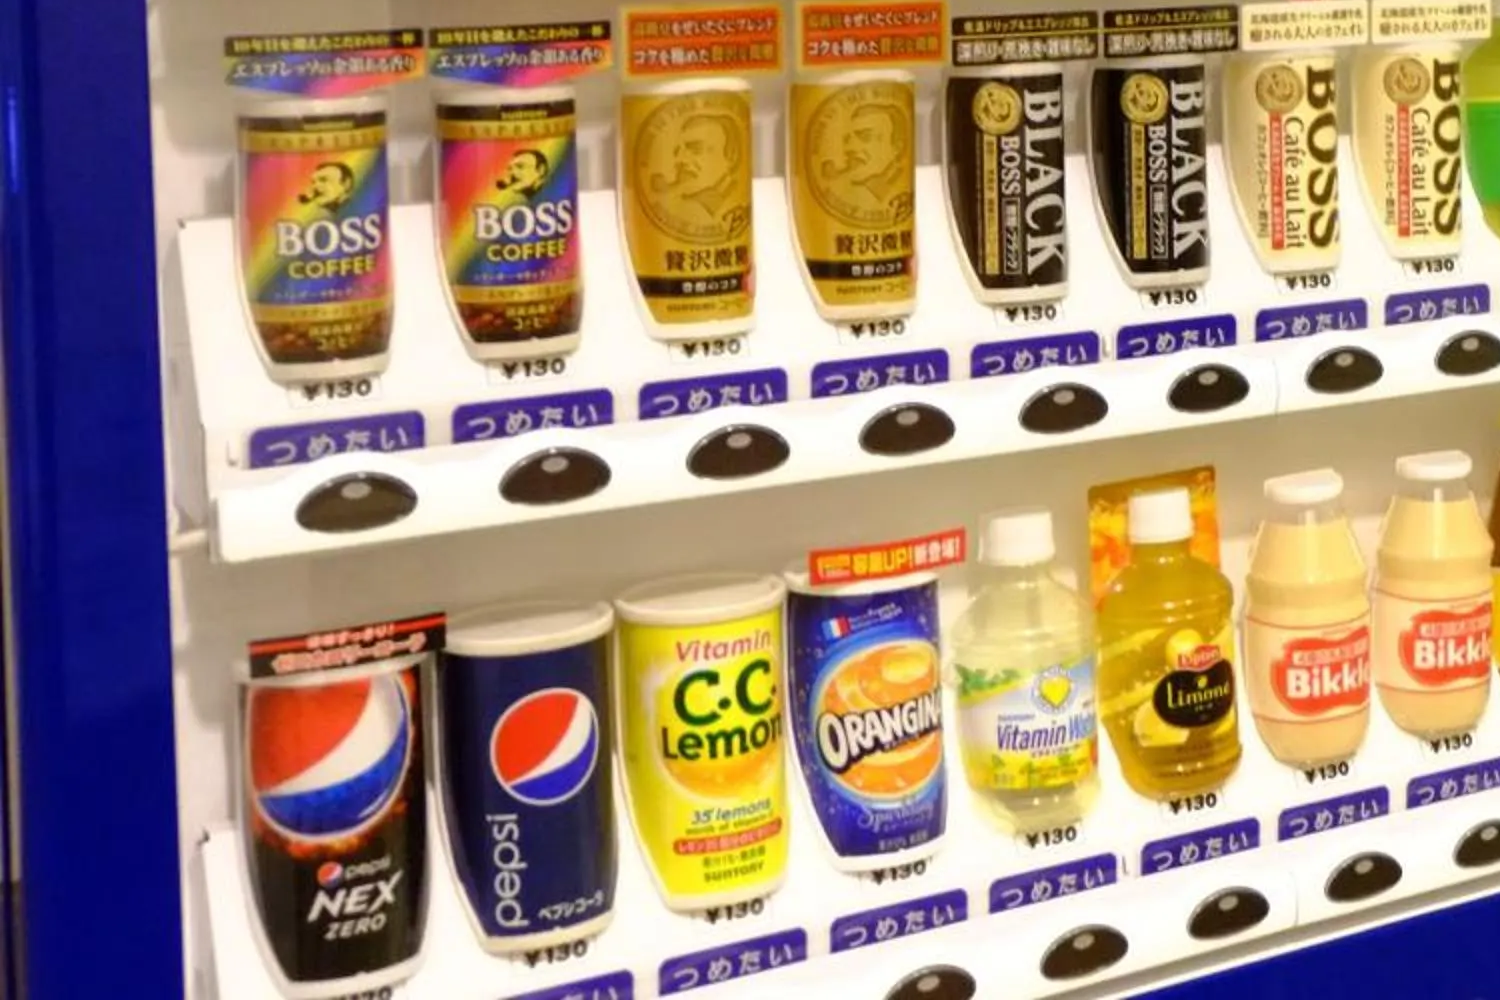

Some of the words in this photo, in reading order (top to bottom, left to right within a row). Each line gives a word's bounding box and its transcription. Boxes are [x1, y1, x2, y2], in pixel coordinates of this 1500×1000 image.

[1283, 115, 1305, 169] Café
[1410, 107, 1430, 157] Café
[1432, 57, 1463, 235] BOSS
[1000, 135, 1023, 196] BOSS
[1148, 123, 1169, 184] BOSS
[1170, 80, 1208, 259] BLACK
[1306, 65, 1340, 248] BOSS
[1022, 89, 1066, 275] BLACK
[276, 214, 383, 257] BOSS
[474, 199, 574, 241] BOSS
[1285, 208, 1307, 249] Lait
[1411, 197, 1433, 237] Lait
[287, 254, 376, 280] COFFEE
[486, 238, 567, 263] COFFEE
[1411, 259, 1456, 275] ¥130
[1148, 288, 1198, 307] ¥130
[1285, 273, 1332, 290] ¥130
[849, 318, 907, 339] ¥130
[1004, 304, 1057, 323] ¥130
[682, 337, 742, 358] ¥130
[502, 357, 567, 379] ¥130
[303, 378, 373, 401] ¥130
[676, 628, 772, 663] Vitamin
[661, 713, 782, 761] Lemon
[997, 722, 1067, 752] Vitamin
[1430, 733, 1474, 755] ¥130
[1304, 760, 1350, 784] ¥130
[1169, 792, 1218, 815] ¥130
[1288, 798, 1381, 838] つめたい
[1026, 826, 1078, 849] ¥130
[1153, 831, 1250, 872] つめたい
[486, 812, 530, 928] pepsi
[871, 860, 928, 885] ¥130
[1001, 867, 1106, 908] つめたい
[307, 870, 403, 922] NEX
[705, 898, 765, 924] ¥130
[324, 912, 387, 940] ZERO
[843, 902, 956, 945] つめたい
[524, 940, 589, 968] ¥130
[673, 941, 794, 988] つめたい
